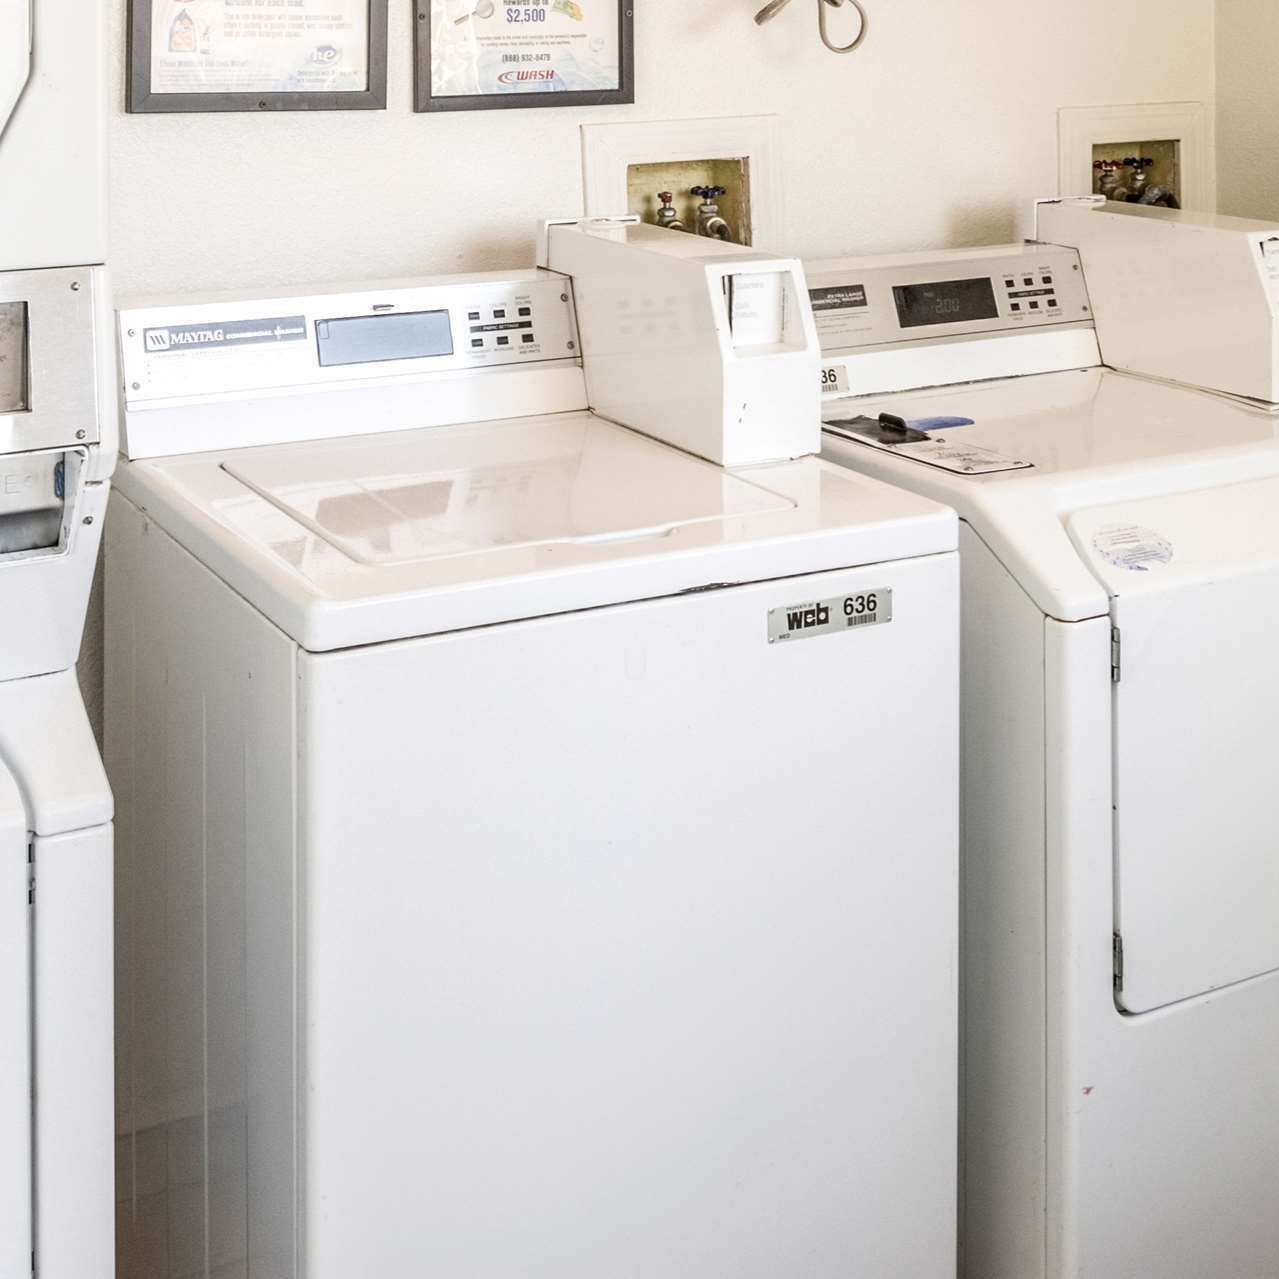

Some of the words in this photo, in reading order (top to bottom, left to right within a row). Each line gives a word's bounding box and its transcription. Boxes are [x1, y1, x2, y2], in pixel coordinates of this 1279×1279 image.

[532, 0, 541, 7] up
[516, 70, 555, 81] WASH
[170, 330, 224, 345] MAYTAG
[843, 593, 877, 615] 636
